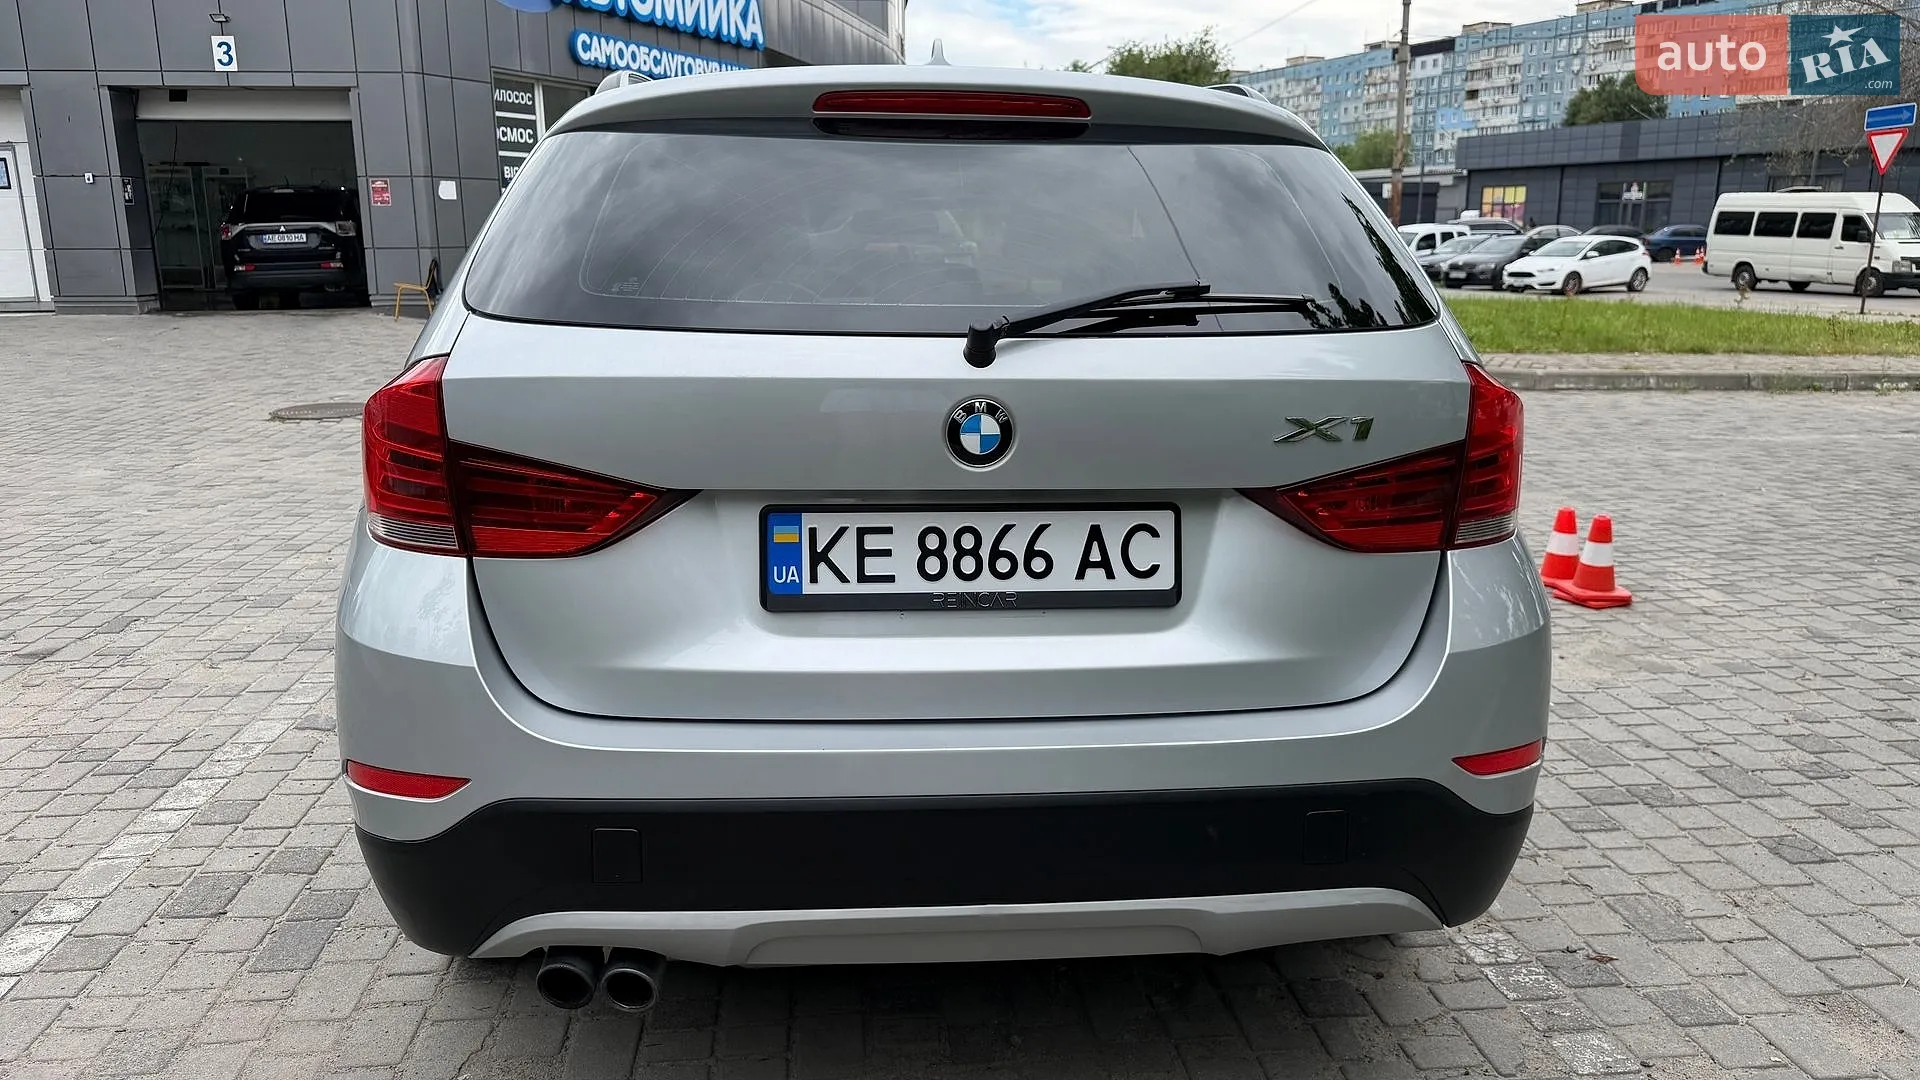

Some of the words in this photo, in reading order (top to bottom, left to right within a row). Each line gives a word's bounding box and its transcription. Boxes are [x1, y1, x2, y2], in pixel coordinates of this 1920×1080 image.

[217, 41, 234, 67] 3
[953, 401, 1008, 424] BMW
[1273, 415, 1375, 442] X1
[808, 525, 896, 584] KE
[916, 523, 1054, 582] 8866
[1074, 523, 1162, 581] AC
[773, 566, 800, 583] UA
[932, 591, 1018, 608] REINCAR
